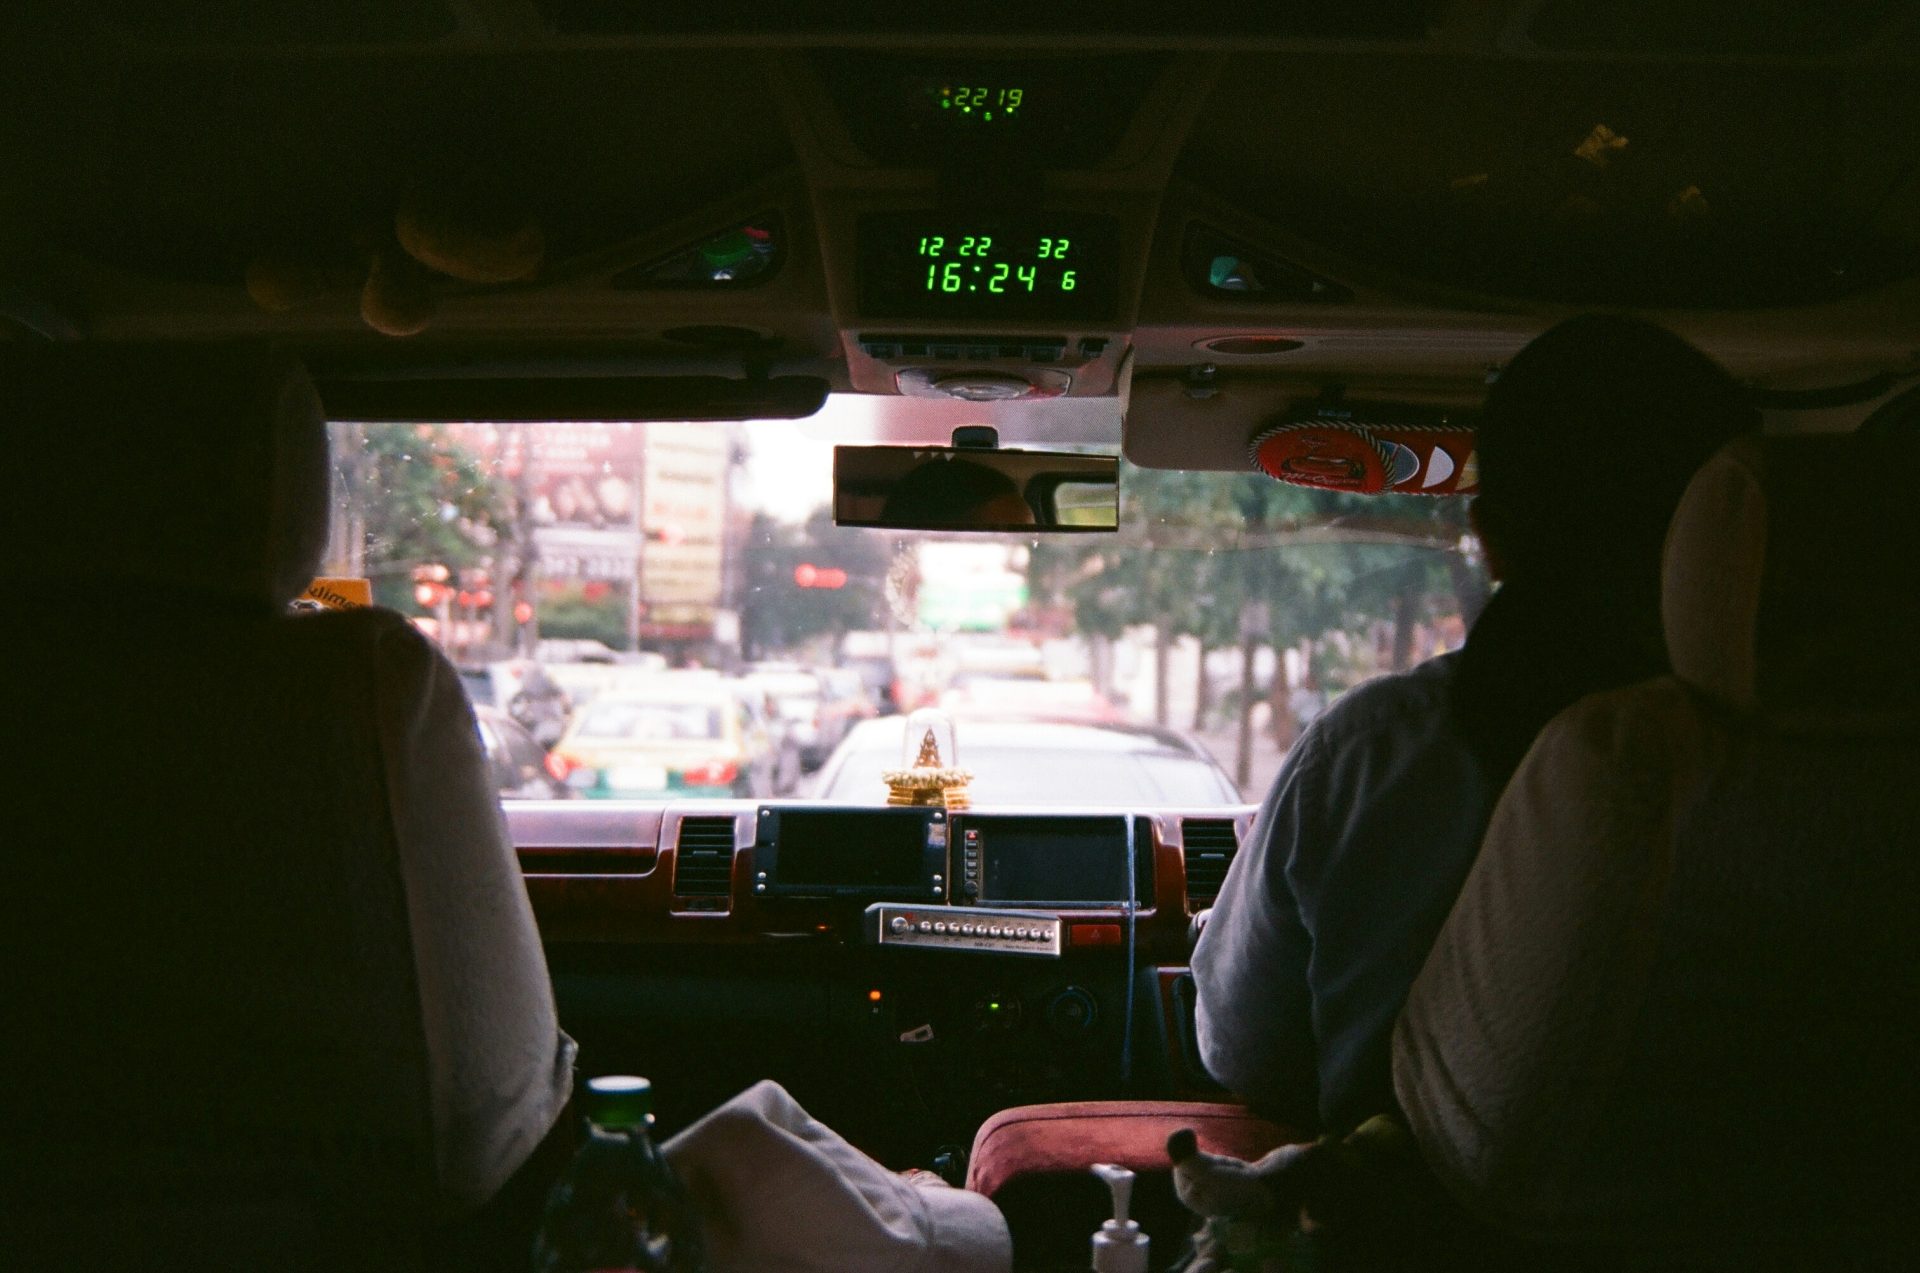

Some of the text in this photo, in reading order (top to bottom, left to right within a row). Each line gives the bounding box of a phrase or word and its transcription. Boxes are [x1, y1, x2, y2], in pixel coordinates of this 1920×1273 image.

[920, 237, 1070, 259] 12 22 32
[926, 263, 1076, 293] 16:24 6
